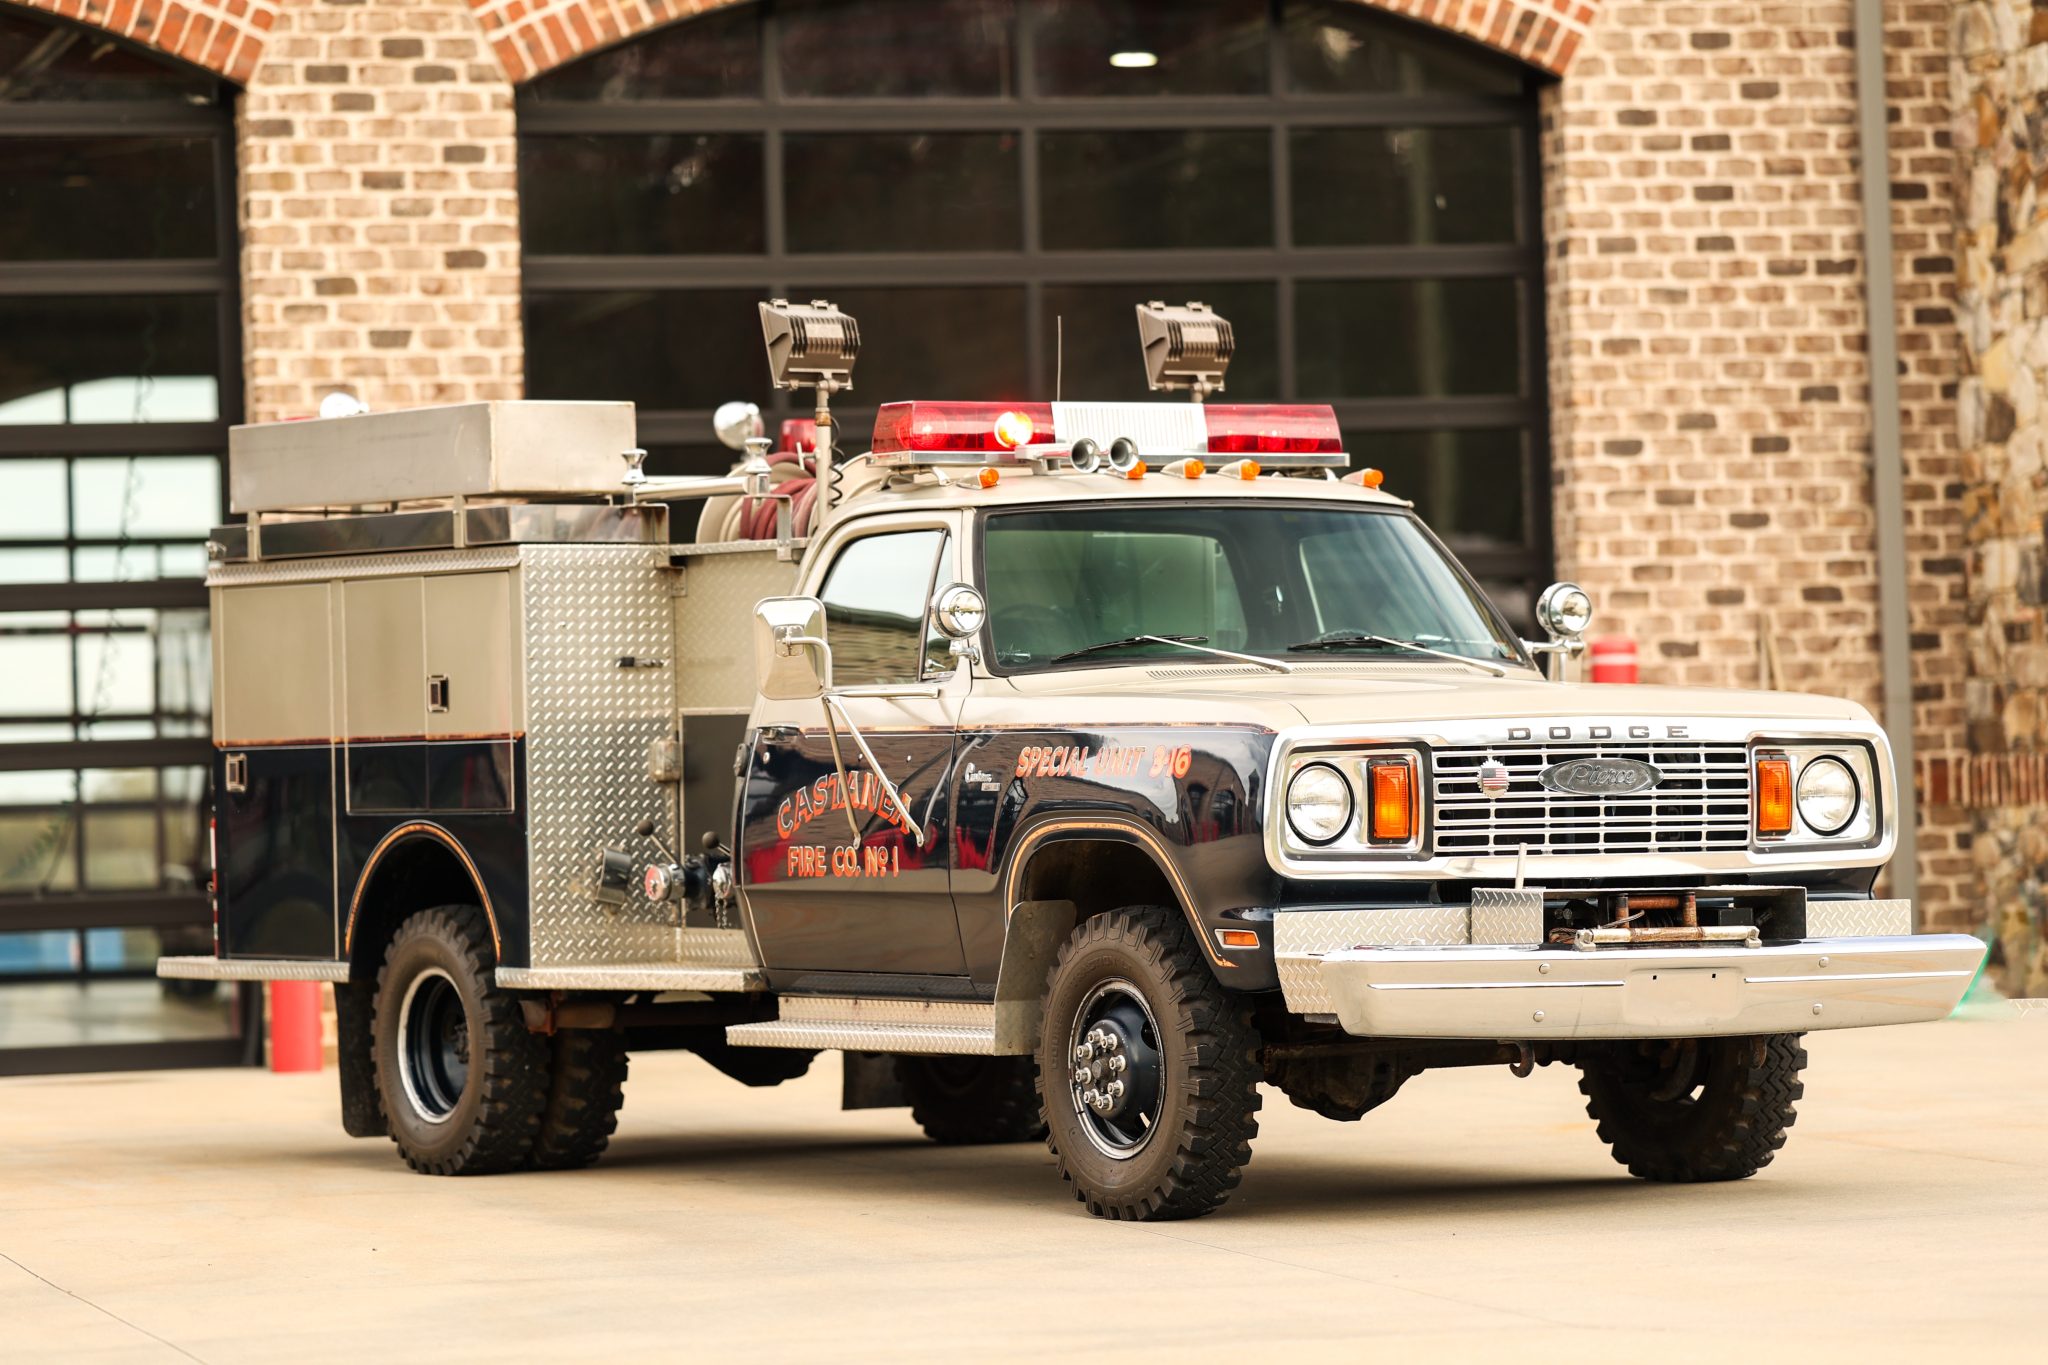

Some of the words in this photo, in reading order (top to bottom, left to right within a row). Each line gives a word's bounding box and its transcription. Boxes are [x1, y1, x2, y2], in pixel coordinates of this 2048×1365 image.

[1508, 725, 1689, 741] DODGE
[1015, 746, 1089, 778] SPECIAL
[1095, 745, 1147, 777] UNIT
[1567, 763, 1636, 790] Pierce
[777, 770, 912, 839] CASTANEA
[787, 845, 827, 877] FIRE
[831, 845, 861, 878] CO.
